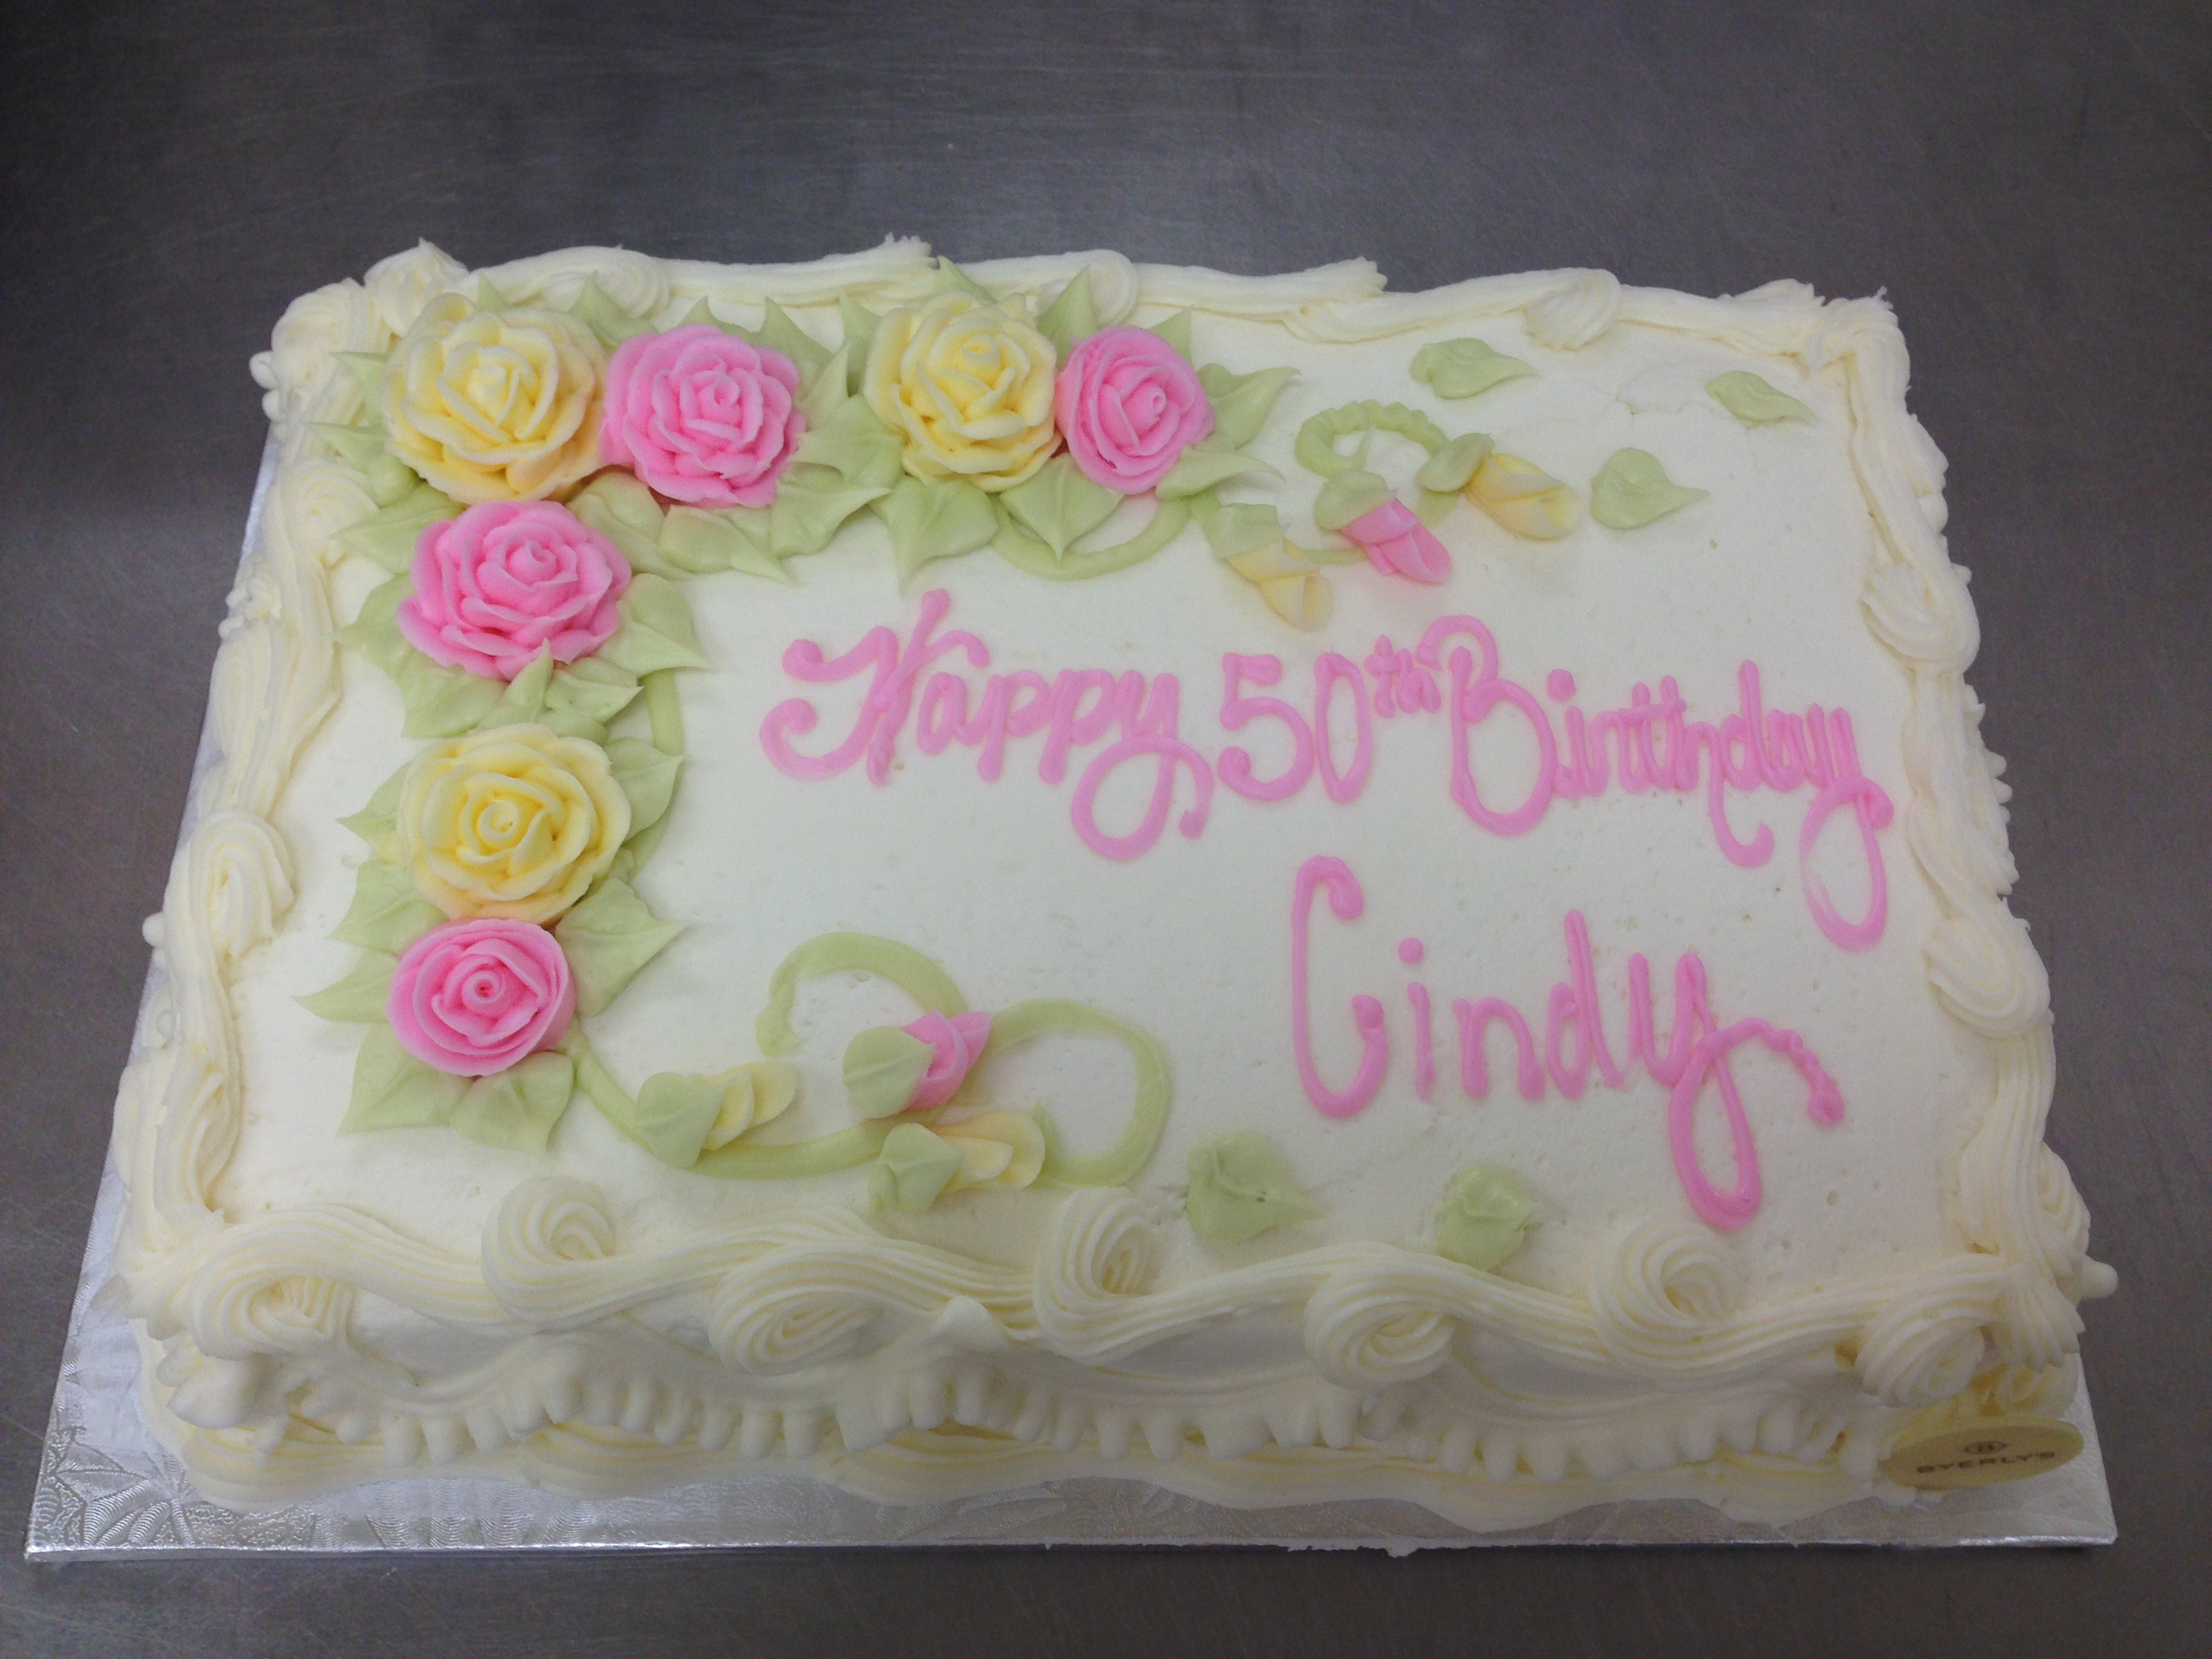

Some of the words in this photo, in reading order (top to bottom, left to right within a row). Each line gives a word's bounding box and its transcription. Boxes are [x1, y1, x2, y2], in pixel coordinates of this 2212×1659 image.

[759, 588, 1214, 861] Happy
[1219, 634, 1441, 804] 50th
[1416, 615, 1895, 951] Birthday
[1291, 855, 1845, 1230] Cindy
